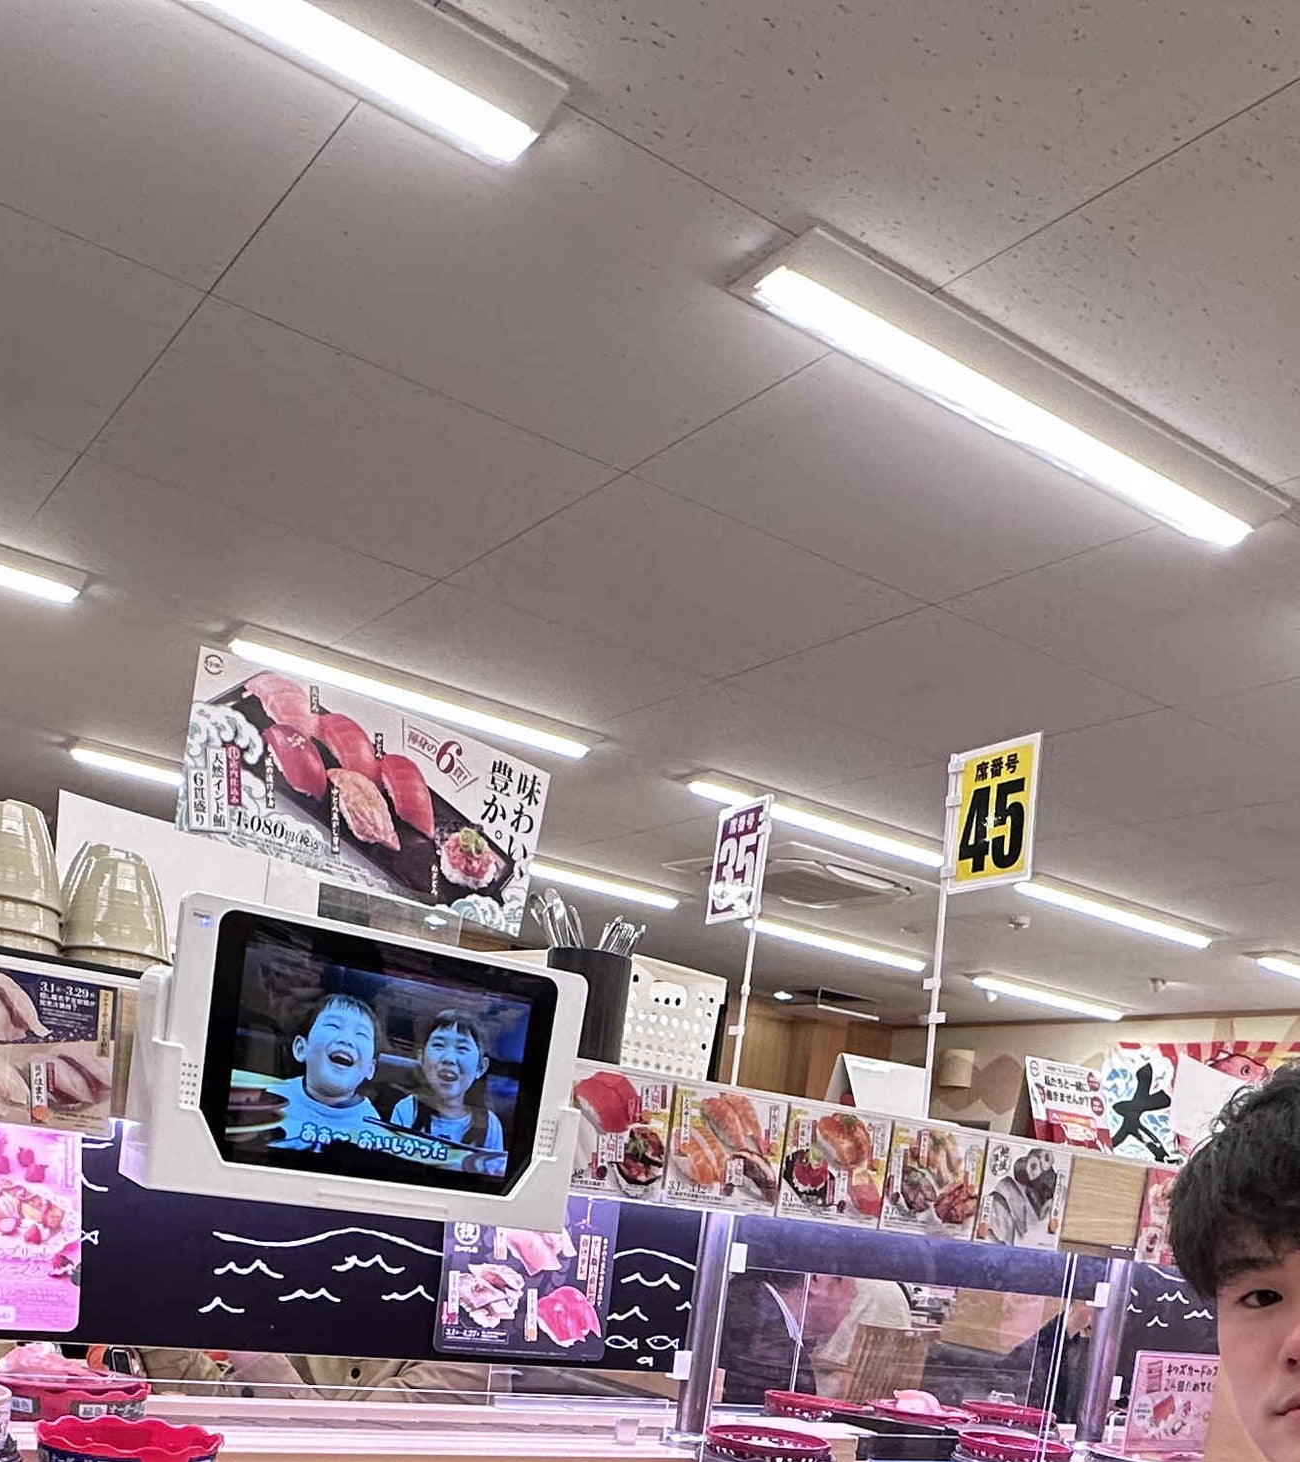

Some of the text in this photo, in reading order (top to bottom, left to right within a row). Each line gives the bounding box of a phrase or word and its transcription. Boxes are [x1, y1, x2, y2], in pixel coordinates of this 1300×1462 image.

[974, 753, 1020, 782] 席番号
[958, 778, 1026, 874] 45
[715, 832, 758, 892] 35
[358, 1129, 449, 1161] おいしかった
